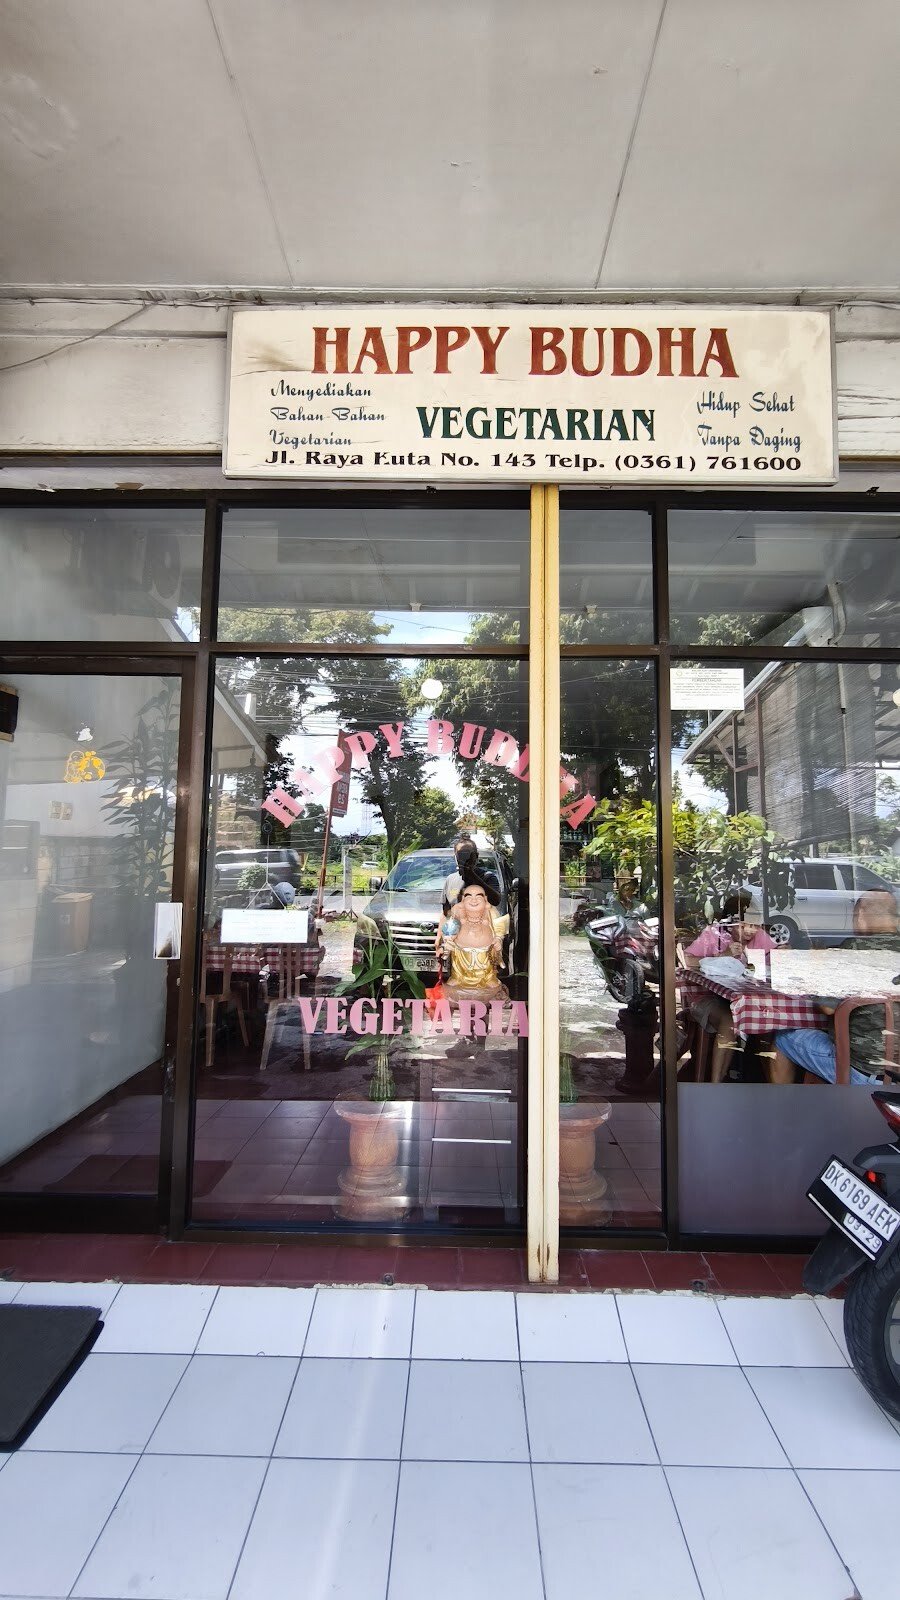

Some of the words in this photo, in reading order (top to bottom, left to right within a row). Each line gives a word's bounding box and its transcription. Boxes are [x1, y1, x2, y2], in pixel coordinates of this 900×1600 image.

[311, 326, 510, 375] HAPPY
[528, 327, 740, 378] BUDHA
[270, 379, 372, 401] Menyediakan
[696, 391, 742, 418] Hidup
[748, 391, 796, 413] Sehat
[415, 406, 656, 442] VEGETARIAN
[696, 424, 742, 452] Tanpa
[749, 426, 802, 453] Daging
[269, 429, 353, 449] Vegetarian
[265, 450, 295, 464] Jl.
[305, 451, 364, 468] Raya
[373, 452, 431, 466] Kuta
[441, 452, 480, 467] No.
[492, 452, 537, 468] 143
[545, 454, 606, 472] Telp.
[614, 454, 697, 472] (0361)
[706, 456, 801, 471] 761600
[261, 720, 405, 829] HAPPY
[824, 1164, 844, 1189] DK
[838, 1178, 871, 1211] 6169
[866, 1203, 898, 1235] AEK
